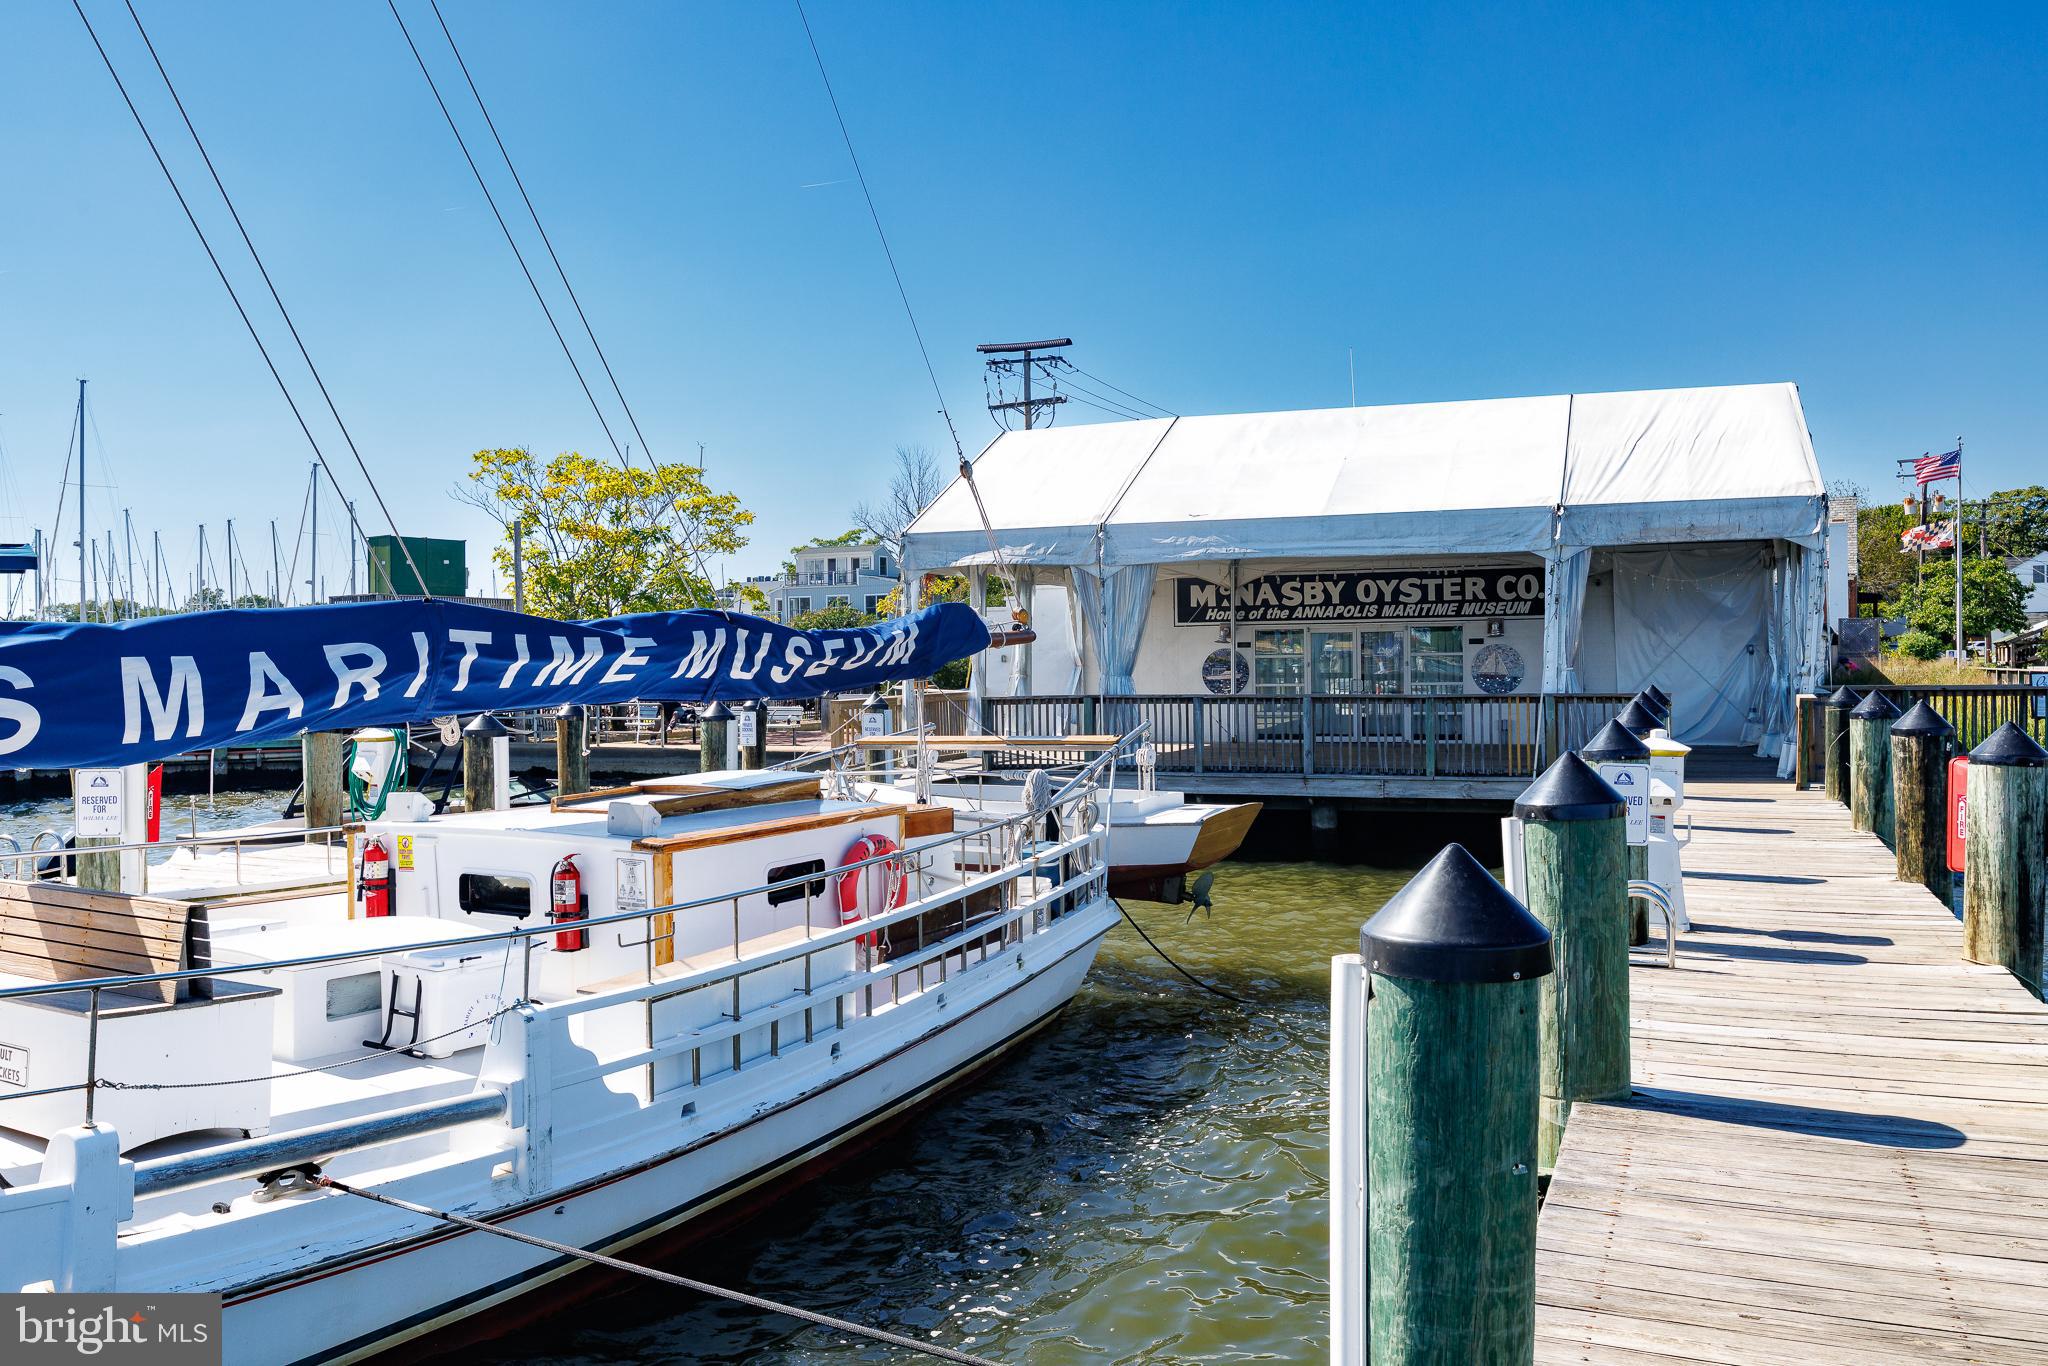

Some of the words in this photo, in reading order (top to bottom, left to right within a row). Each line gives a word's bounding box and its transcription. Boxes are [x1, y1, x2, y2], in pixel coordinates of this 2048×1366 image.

[1356, 577, 1487, 603] OYSTER
[1497, 574, 1545, 601] CO.
[1249, 608, 1265, 620] of
[1266, 607, 1288, 619] the
[1292, 604, 1379, 618] ANNAPOLIS
[1381, 602, 1458, 617] MARITIME
[1461, 601, 1532, 615] MUSEUM
[121, 629, 657, 745] MARITIME
[671, 624, 920, 684] MUSEUM
[81, 795, 118, 805] RESERVED
[93, 805, 107, 813] FOR
